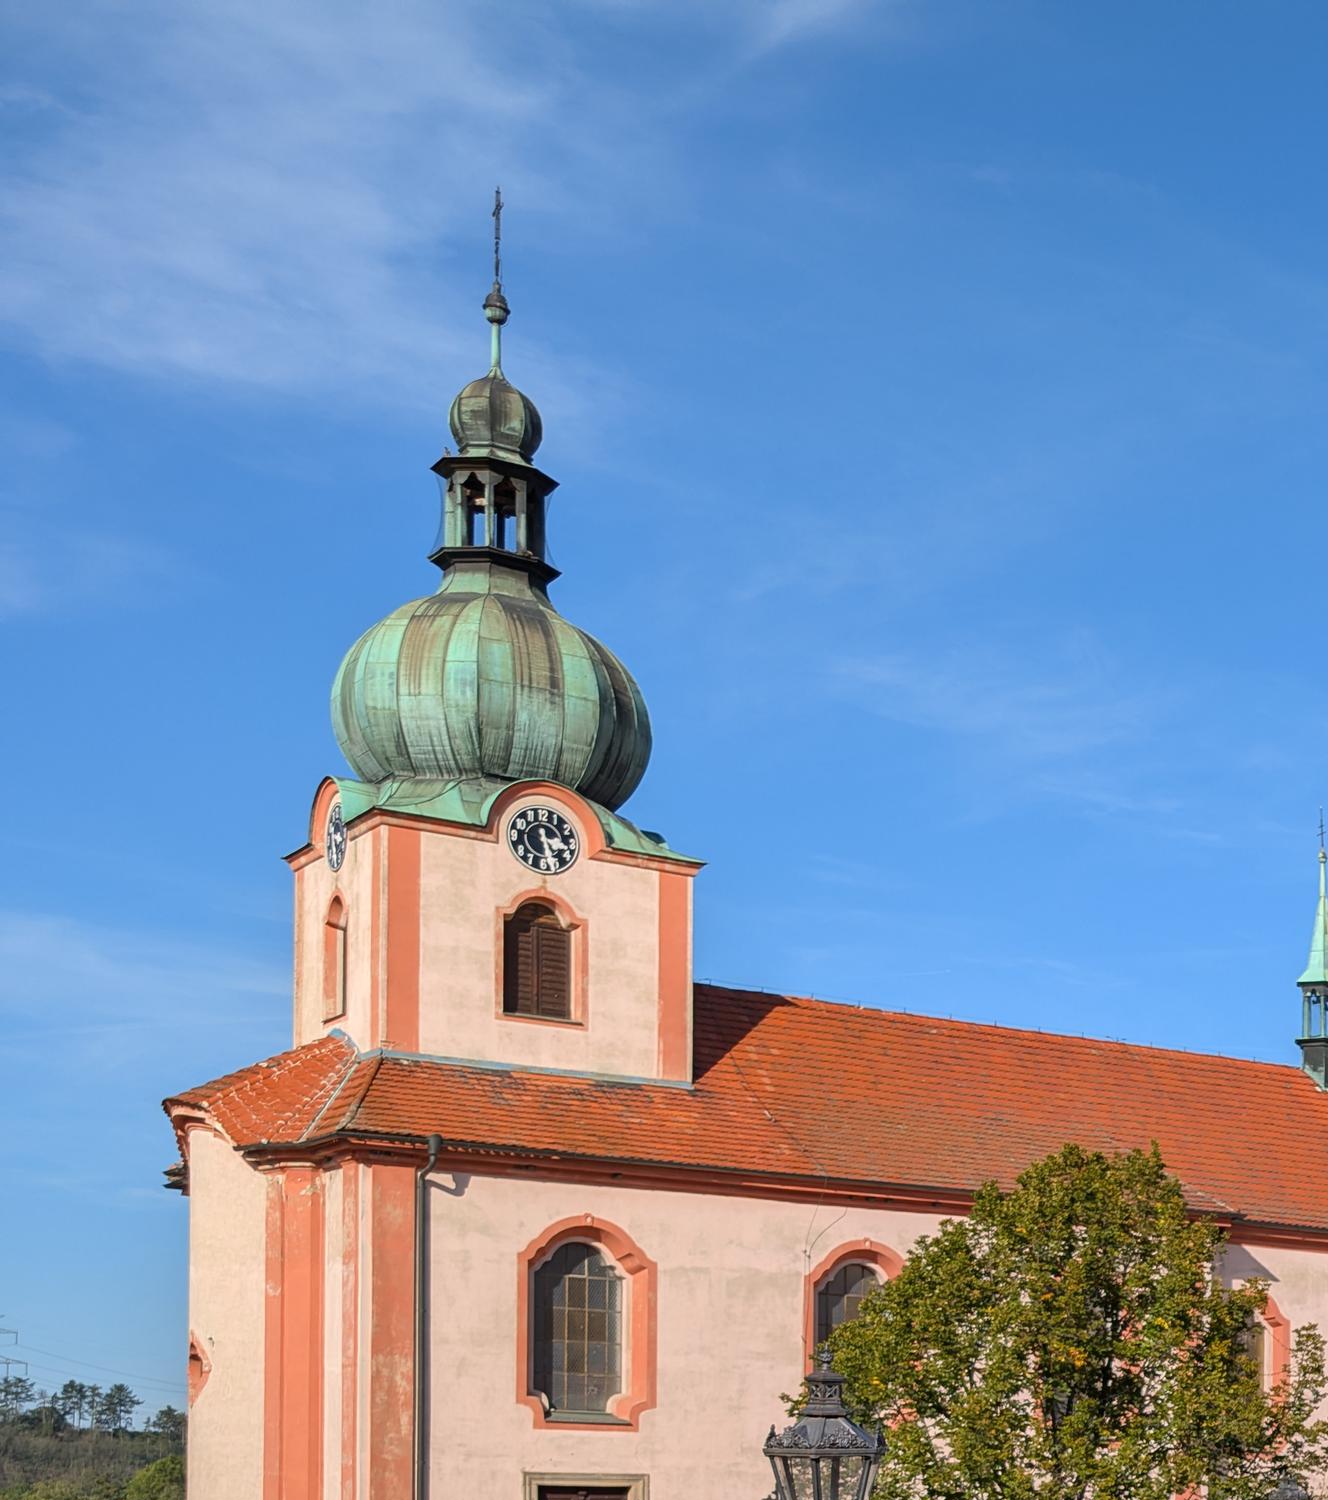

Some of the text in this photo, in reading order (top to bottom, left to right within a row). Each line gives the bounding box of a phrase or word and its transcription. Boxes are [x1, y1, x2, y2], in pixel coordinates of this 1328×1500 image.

[527, 810, 534, 822] 11
[538, 810, 549, 821] 12
[553, 814, 558, 825] 1
[516, 818, 526, 830] 10
[563, 824, 571, 835] 2
[511, 829, 518, 841] 9
[569, 839, 576, 850] 3
[517, 845, 524, 856] 8
[563, 850, 571, 861] 4
[527, 854, 534, 865] 7
[540, 858, 547, 870] 6
